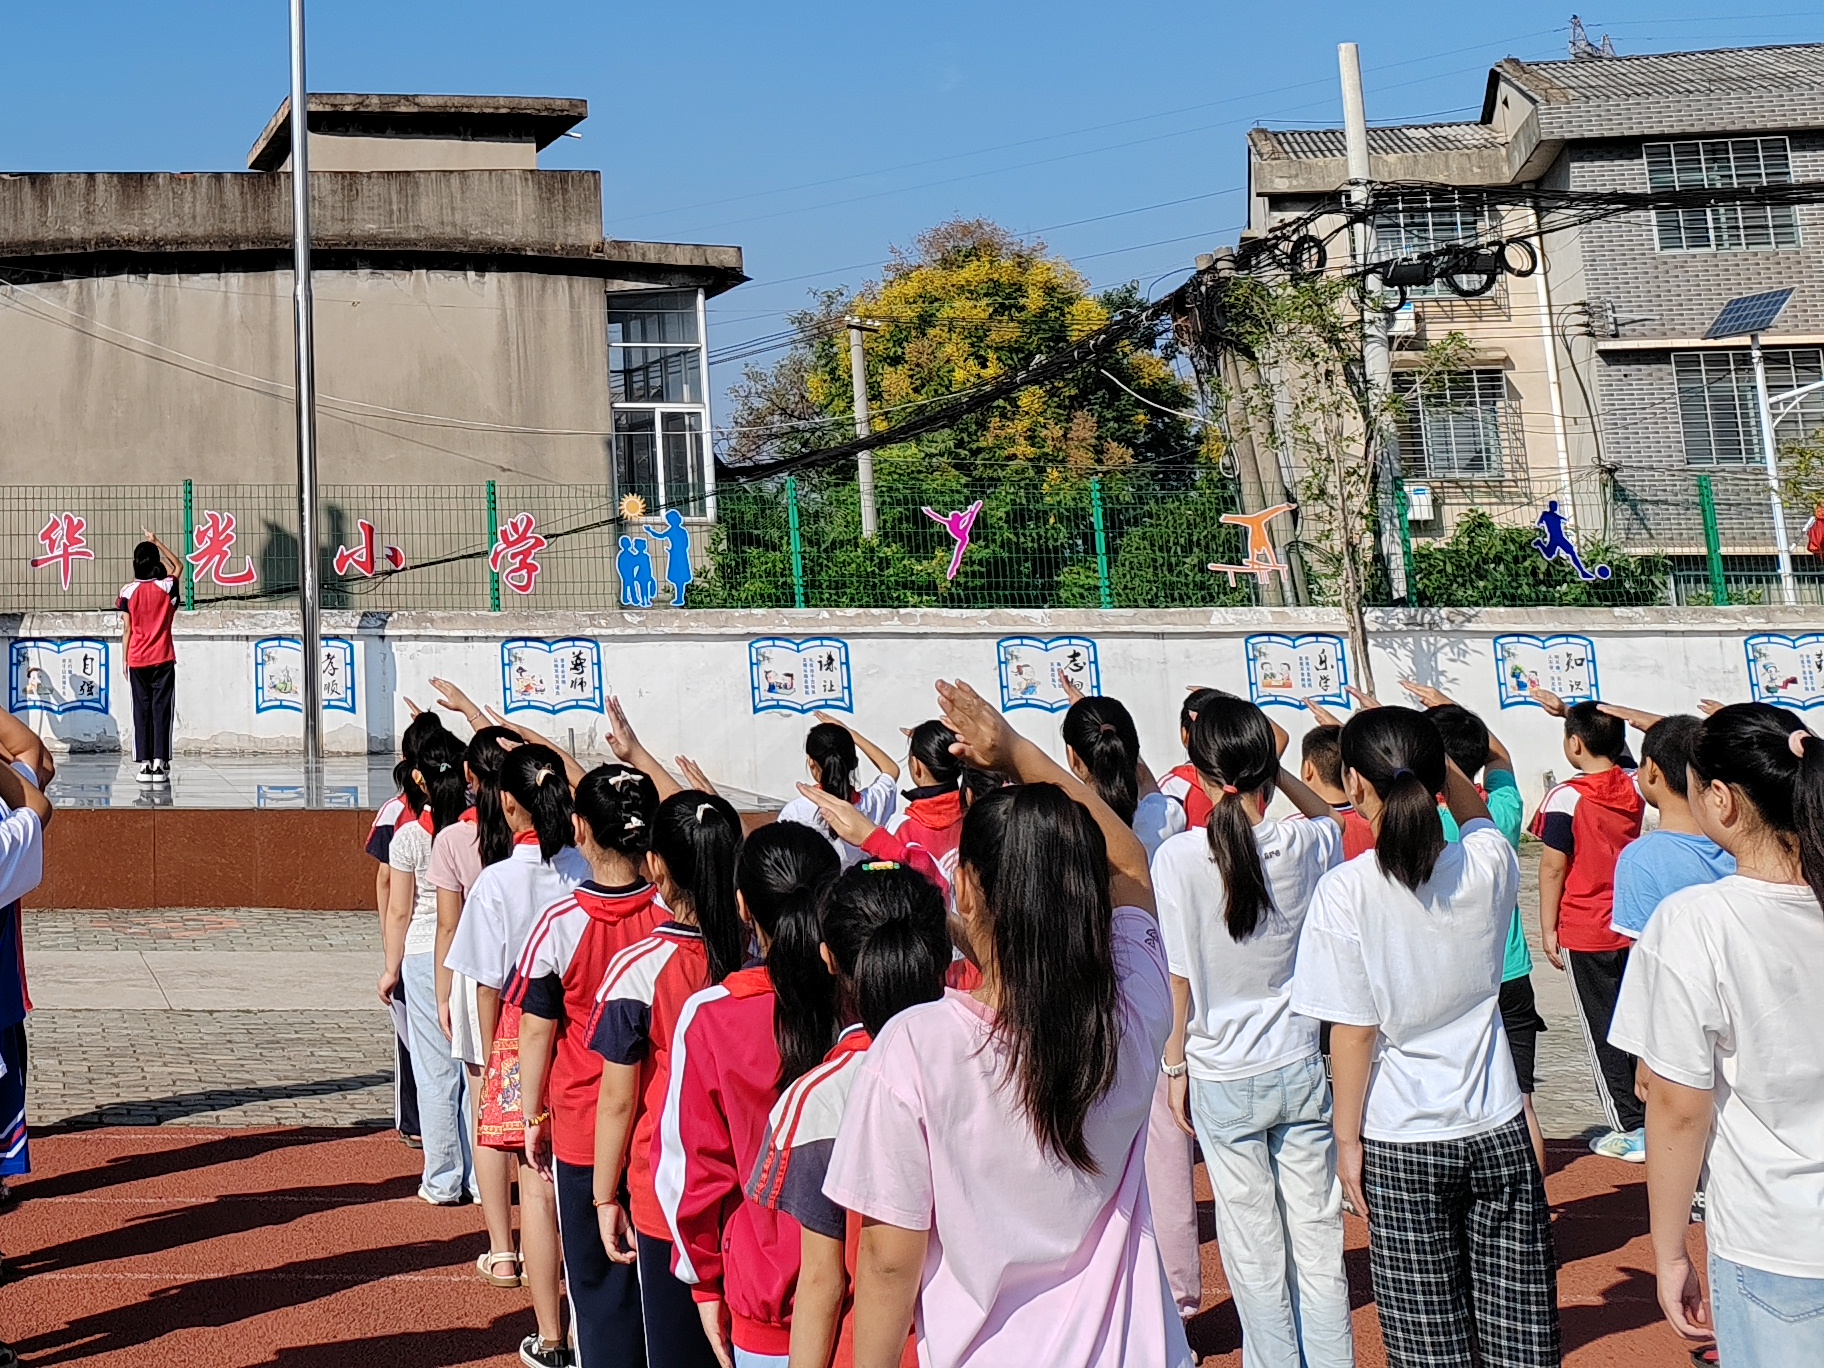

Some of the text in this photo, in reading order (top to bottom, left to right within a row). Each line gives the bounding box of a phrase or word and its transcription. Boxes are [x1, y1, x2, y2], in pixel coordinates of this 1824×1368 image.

[31, 510, 548, 596] 华光小学
[78, 653, 95, 697] 自强
[321, 652, 342, 696] 孝顺
[569, 650, 587, 693] 尊师
[817, 650, 838, 693] 谦让
[1565, 651, 1586, 693] 知识
